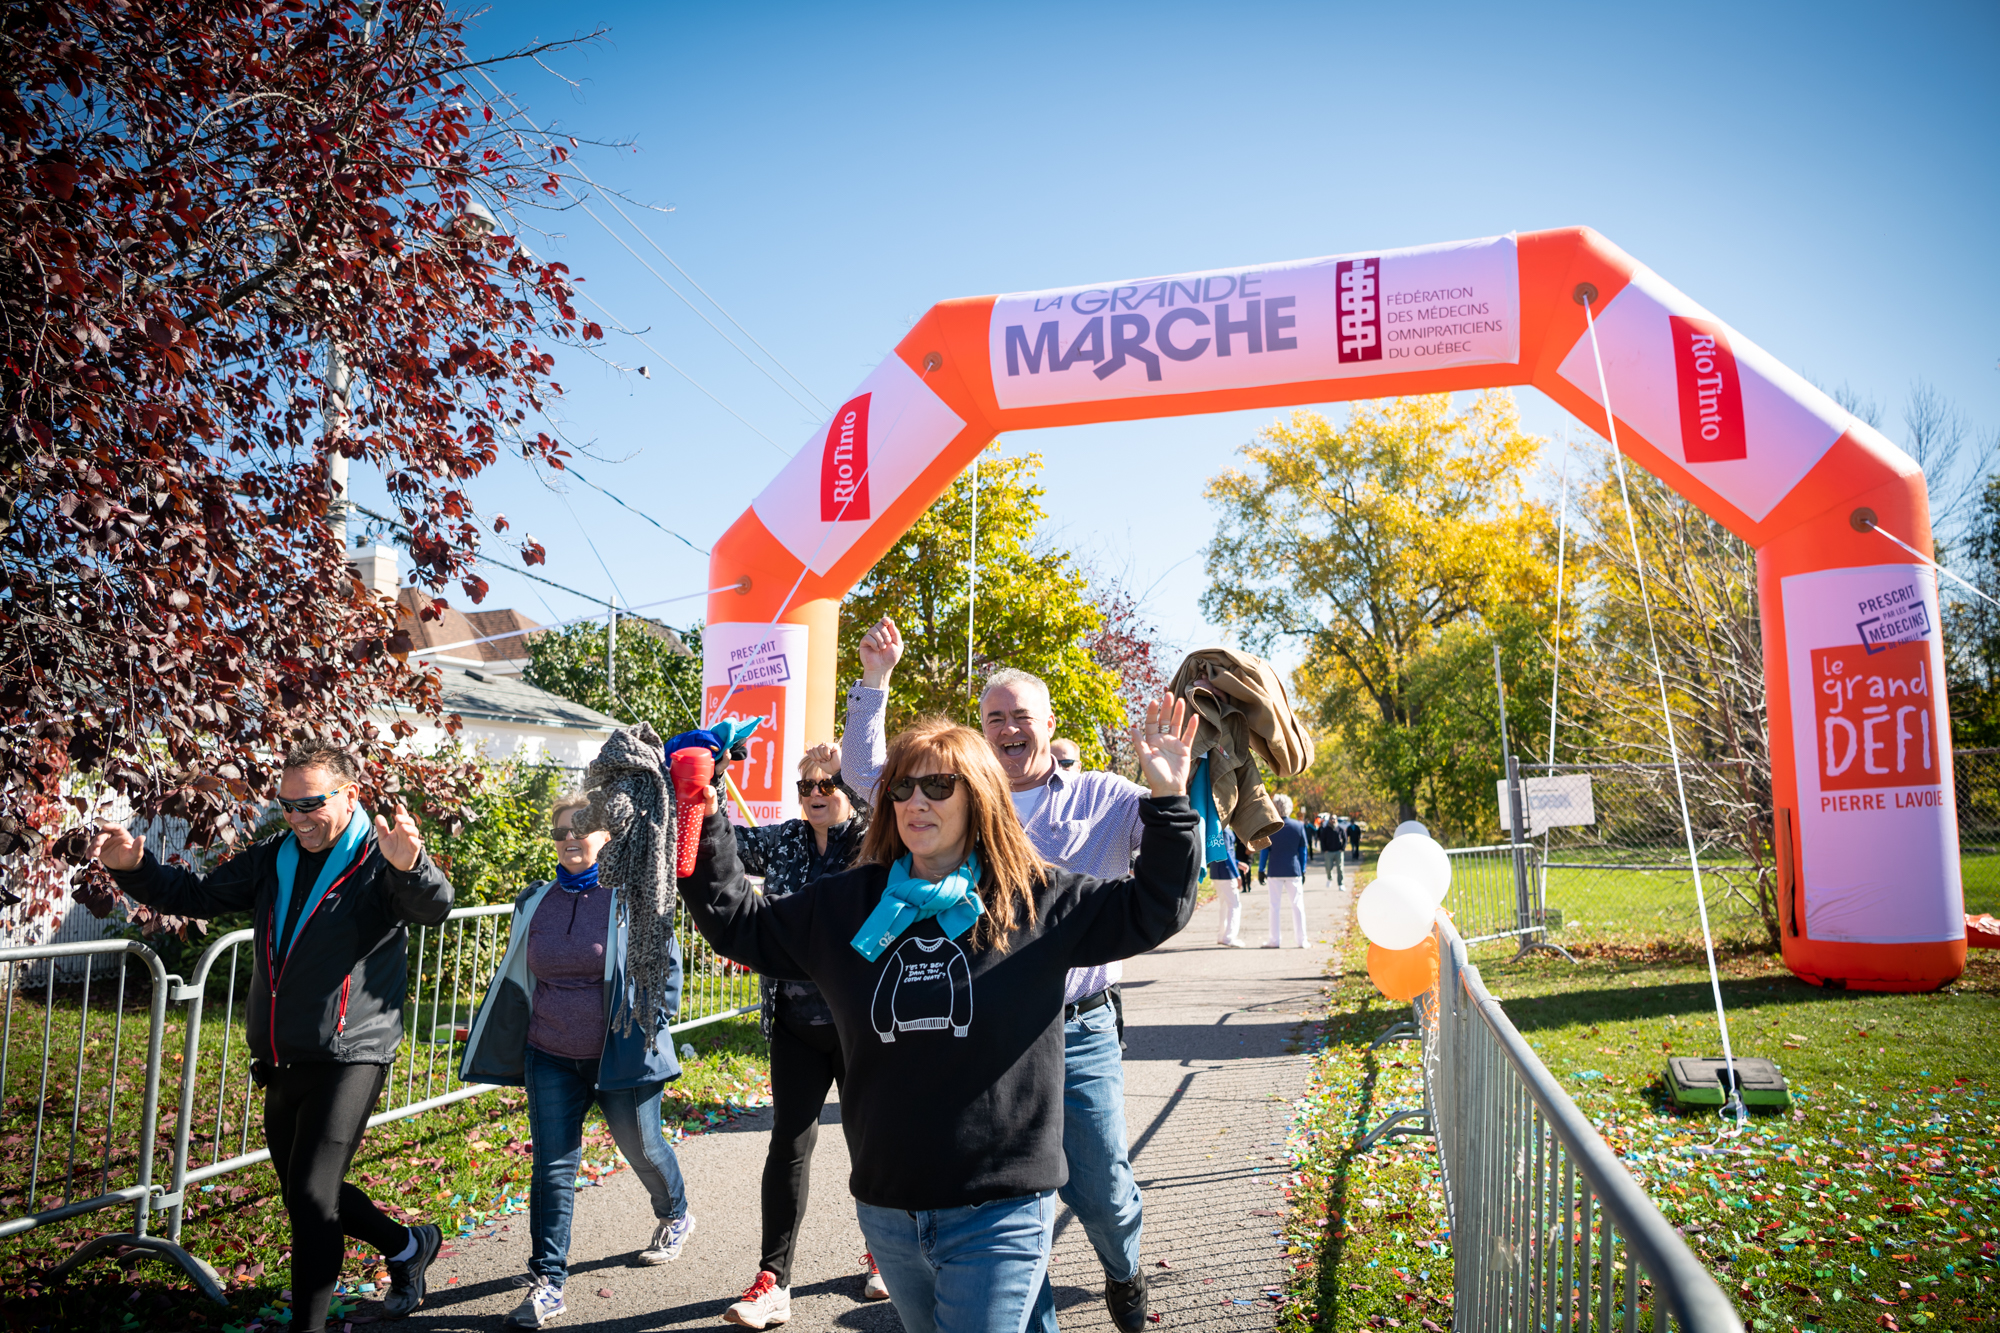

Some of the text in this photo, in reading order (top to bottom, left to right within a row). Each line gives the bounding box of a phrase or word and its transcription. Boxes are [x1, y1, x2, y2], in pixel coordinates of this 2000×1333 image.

[1033, 271, 1263, 316] LA GRANDE
[1386, 287, 1474, 306] FÉDÉRATION
[1387, 303, 1490, 324] DES MÉDECINS
[1005, 295, 1298, 382] MARCHE
[1387, 319, 1503, 342] OMNIPRATICIENS
[1389, 341, 1472, 359] DU QUÉBEC
[1858, 584, 1915, 615] PRESCRIT
[1882, 605, 1907, 620] PAR LES
[1868, 612, 1925, 643] MÉDECINS
[1823, 655, 1844, 676] le
[1822, 660, 1928, 714] grand
[709, 693, 719, 709] le
[1820, 790, 1943, 813] PIERRE LAVOIE
